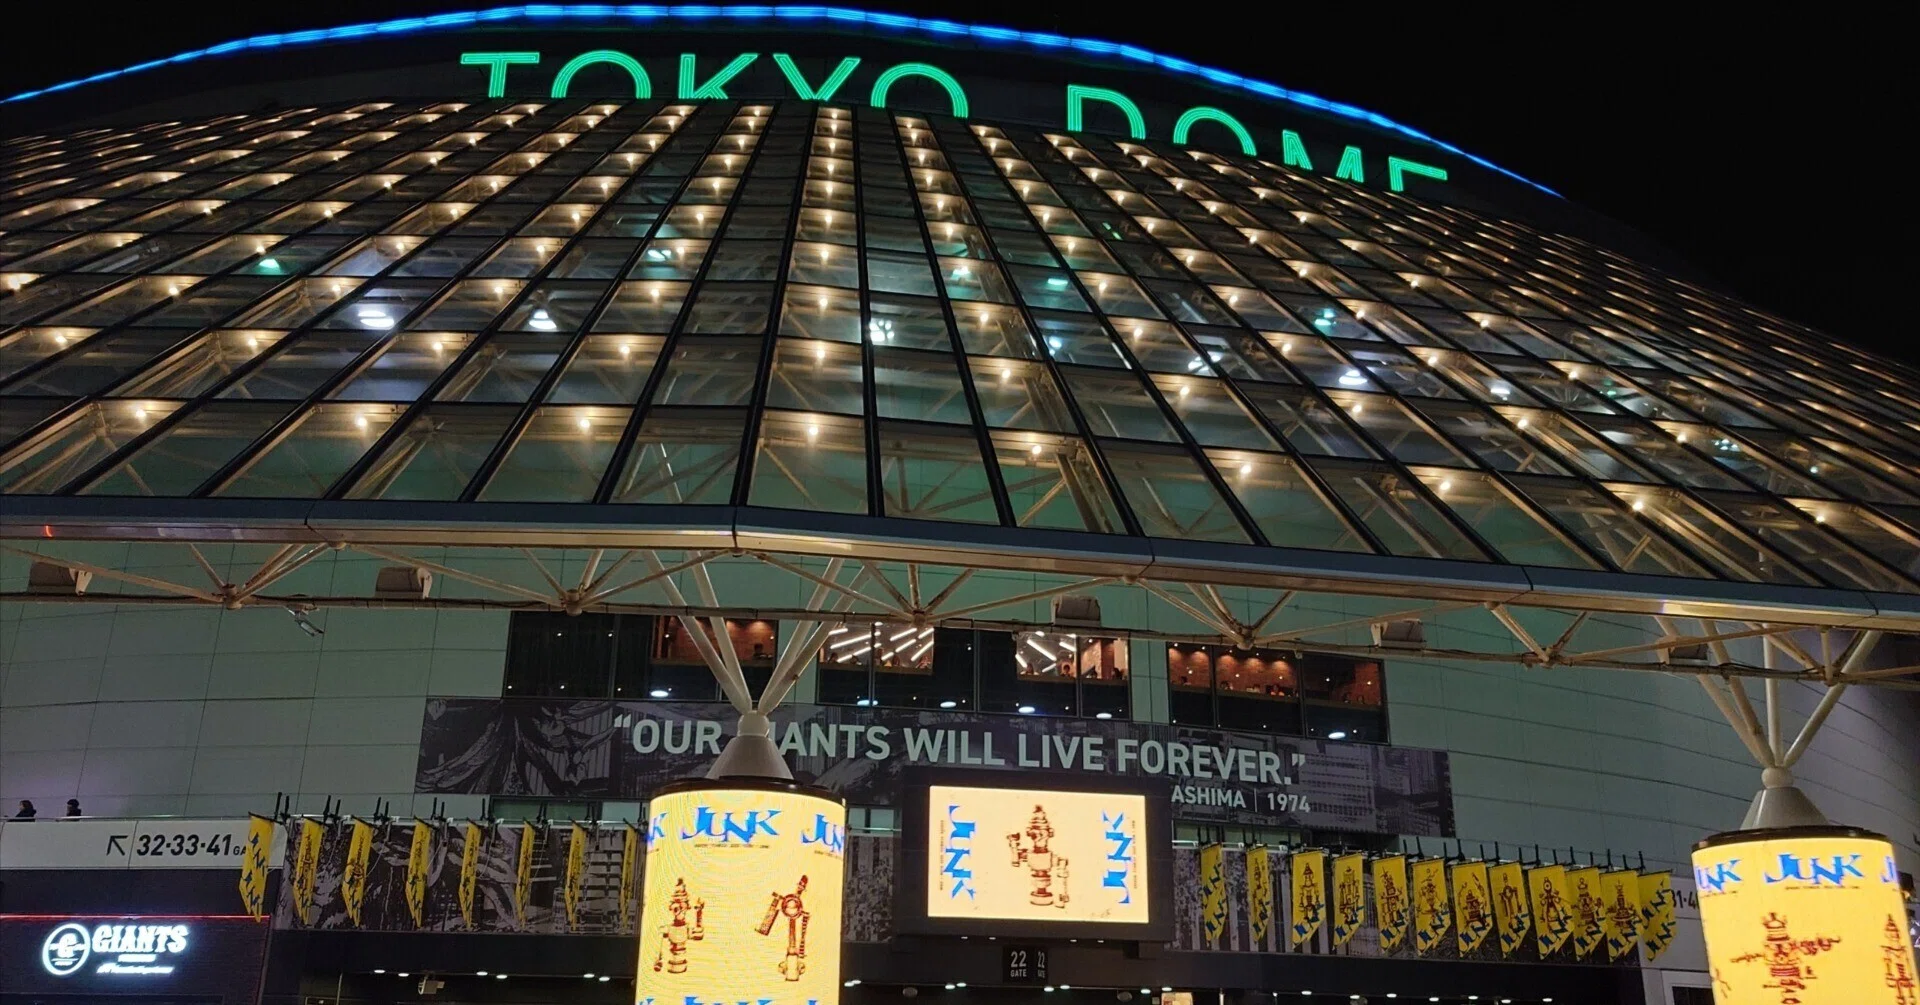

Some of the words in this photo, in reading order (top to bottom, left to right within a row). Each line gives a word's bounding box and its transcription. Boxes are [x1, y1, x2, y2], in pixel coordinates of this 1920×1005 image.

[768, 721, 890, 760] ANTS
[904, 727, 1005, 766] WILL
[1018, 733, 1103, 771] LIVE
[1117, 738, 1306, 785] FOREVER.”
[1267, 792, 1311, 813] 1974
[682, 807, 782, 843] JUNK
[802, 814, 843, 853] JUN
[942, 805, 977, 900] JUNK
[1103, 811, 1133, 904] JUNK
[1695, 859, 1742, 892] UNK
[1764, 854, 1864, 885] JUNK
[91, 925, 189, 953] GIANTS
[1010, 950, 1027, 968] 22
[1010, 969, 1027, 978] GATE
